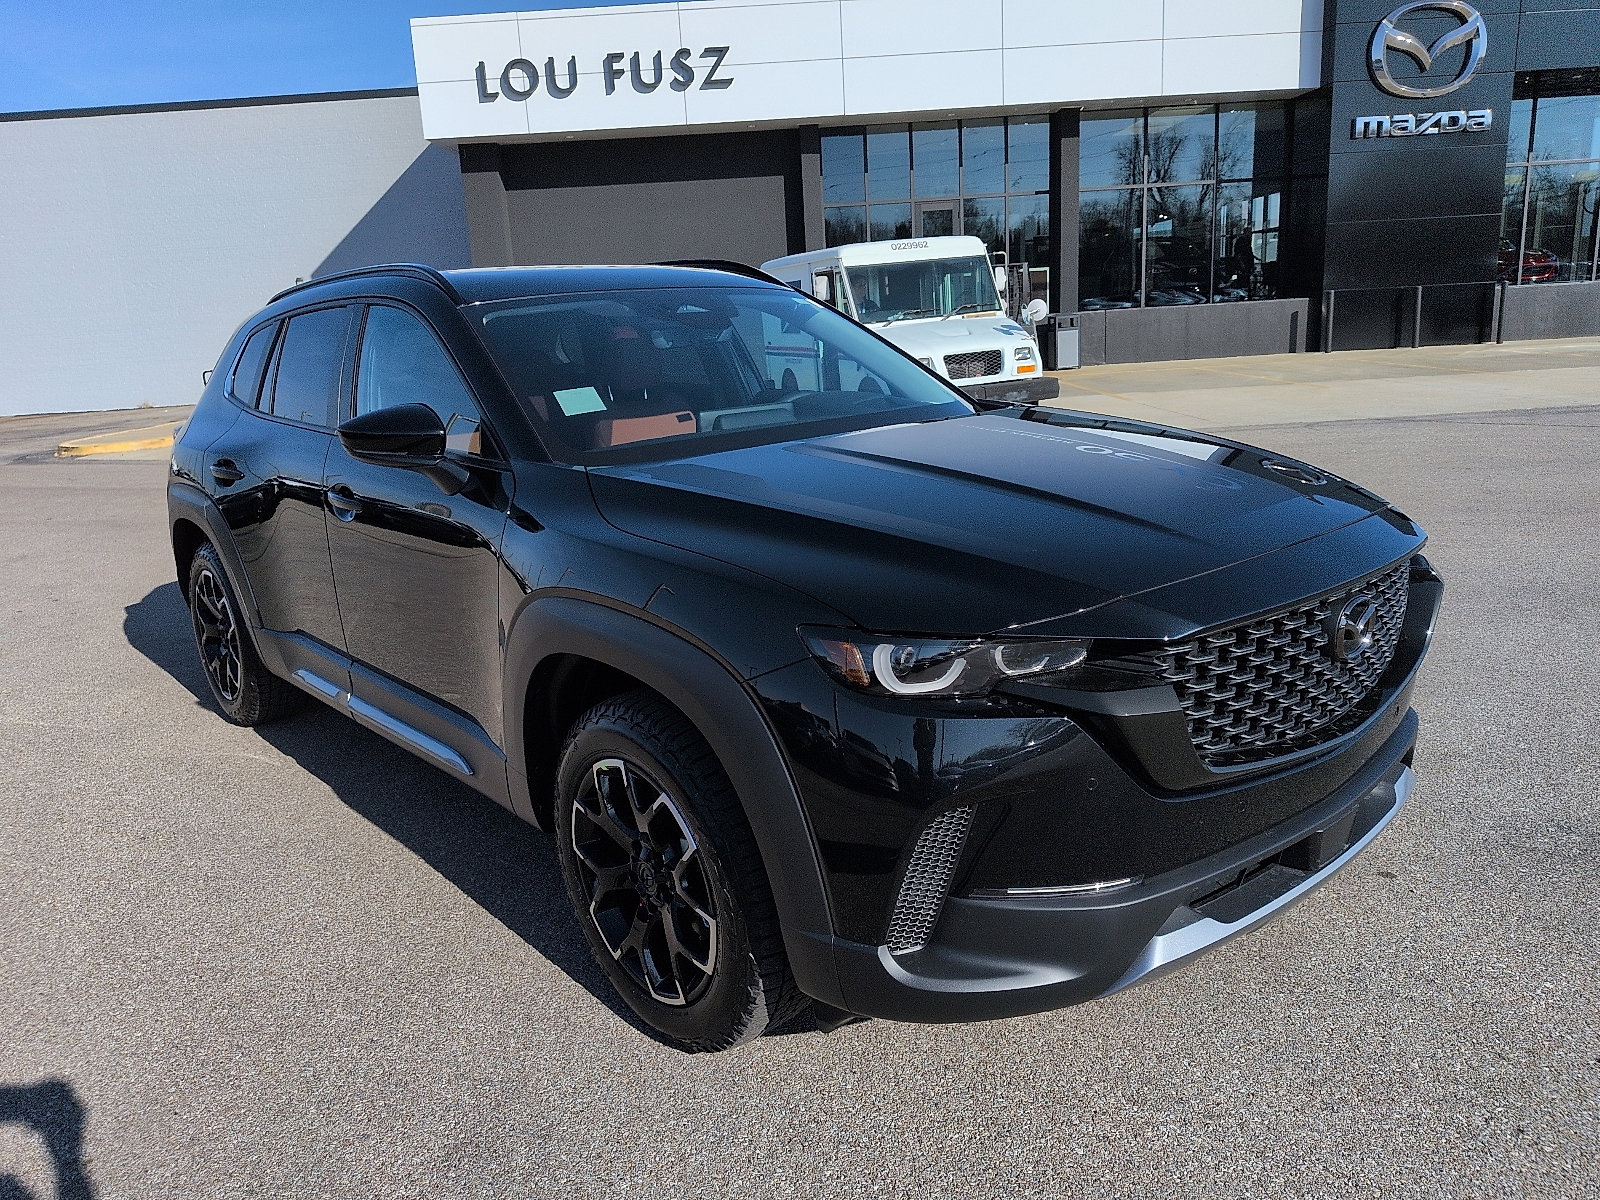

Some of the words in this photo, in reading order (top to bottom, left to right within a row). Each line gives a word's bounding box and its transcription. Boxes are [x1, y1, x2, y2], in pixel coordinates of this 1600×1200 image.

[475, 55, 578, 104] LOU
[602, 46, 734, 96] FUSZ
[1354, 108, 1493, 139] mazda
